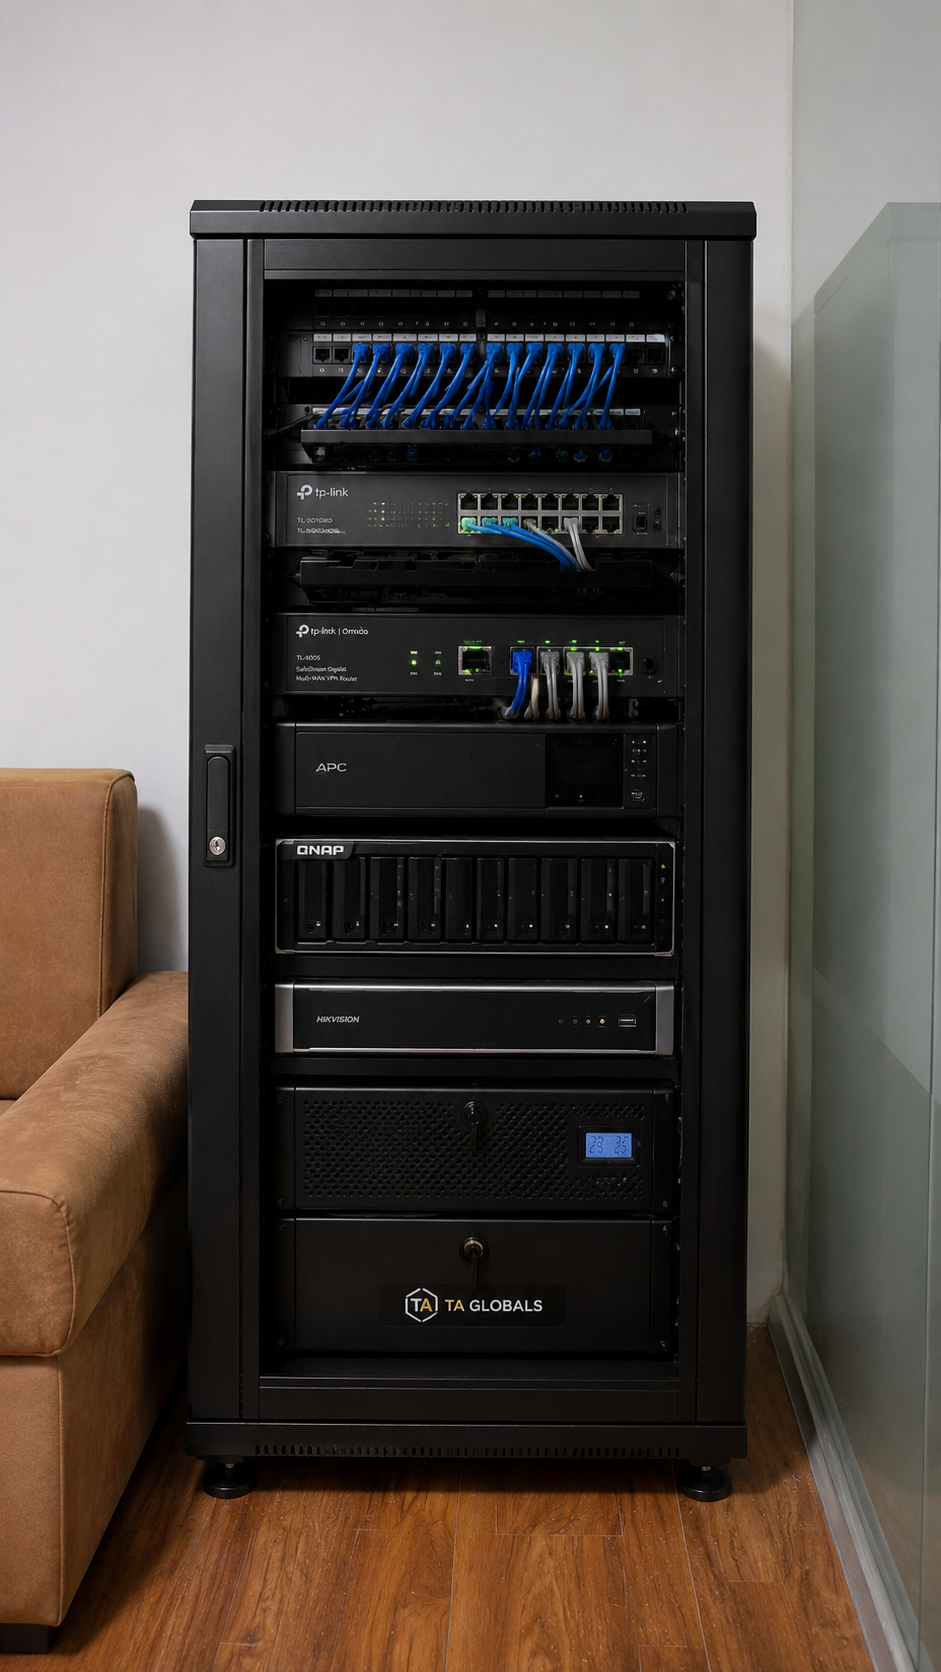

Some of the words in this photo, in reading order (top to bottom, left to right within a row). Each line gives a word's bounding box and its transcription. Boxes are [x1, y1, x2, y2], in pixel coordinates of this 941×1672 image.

[315, 487, 349, 500] tp-link
[315, 763, 347, 772] APC
[296, 845, 345, 856] QNAP
[410, 1299, 433, 1312] TA
[444, 1299, 466, 1312] TA
[469, 1299, 544, 1312] GLOBALS
